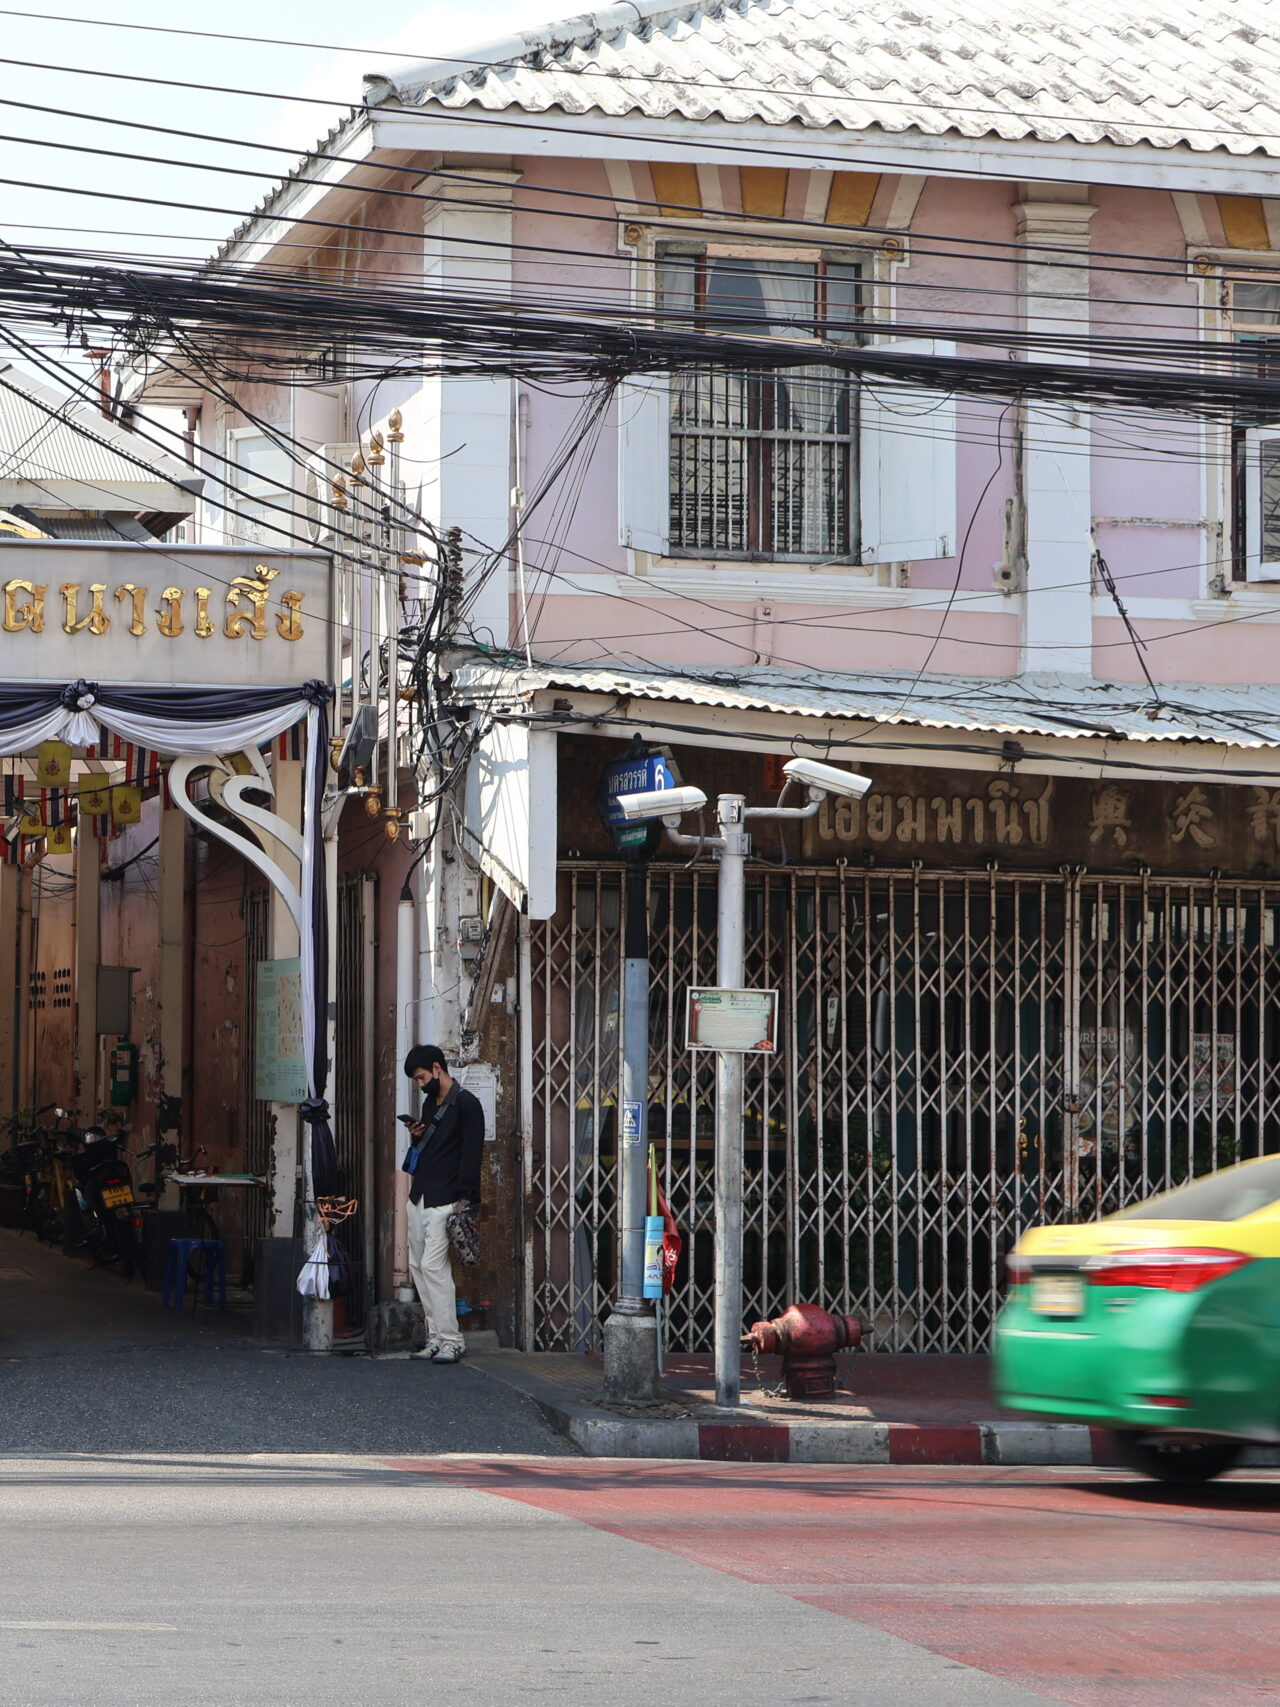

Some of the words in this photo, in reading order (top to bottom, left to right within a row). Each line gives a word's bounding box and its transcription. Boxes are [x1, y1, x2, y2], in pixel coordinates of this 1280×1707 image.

[608, 758, 649, 794] นครสวรรค์
[654, 764, 665, 791] 6
[1059, 1032, 1134, 1045] SRDOUH
